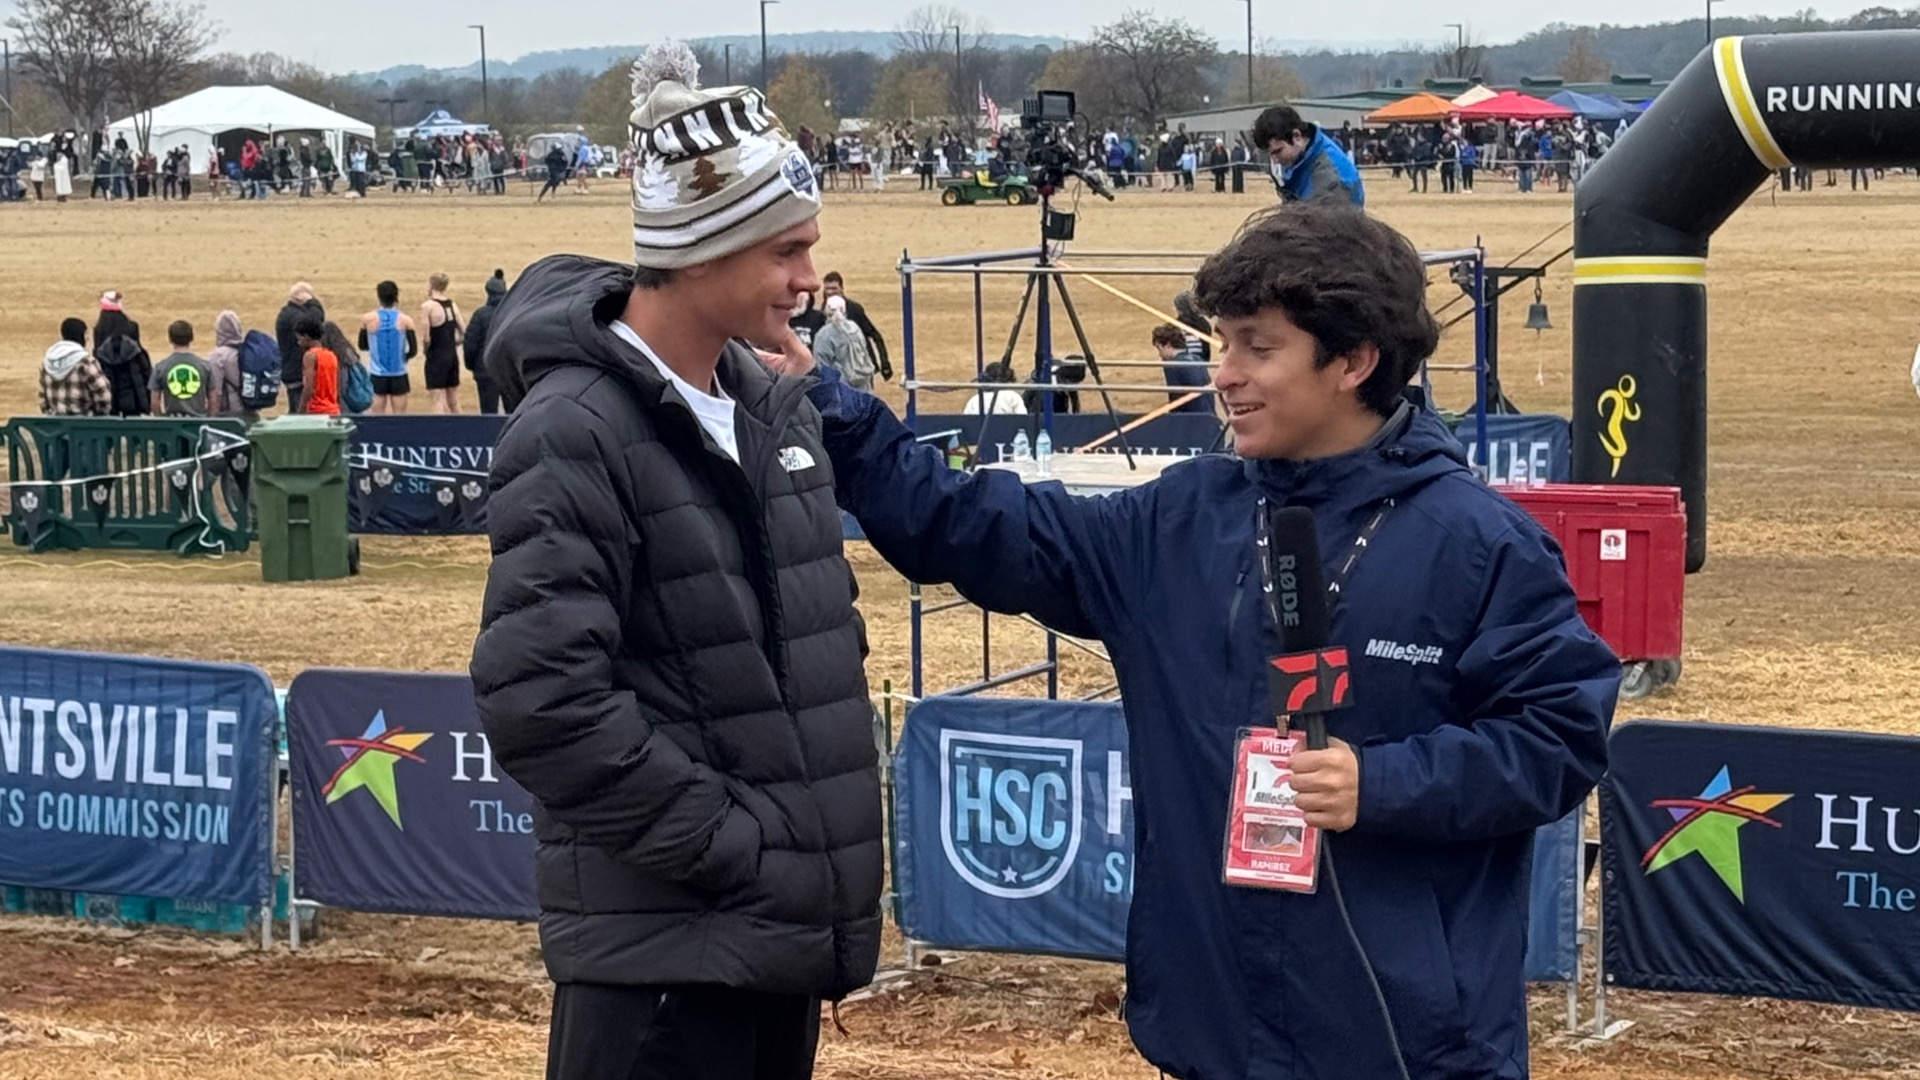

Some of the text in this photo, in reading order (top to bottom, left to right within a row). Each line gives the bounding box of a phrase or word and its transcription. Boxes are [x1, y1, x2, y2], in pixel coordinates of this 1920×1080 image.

[1766, 82, 1920, 113] RUNNIN
[1279, 555, 1300, 627] RØDE
[1364, 638, 1444, 666] MileSplit
[37, 791, 229, 845] COMMISSION
[469, 799, 535, 834] The
[955, 764, 1067, 850] HSC
[1103, 852, 1134, 894] S
[1836, 870, 1916, 912] The
